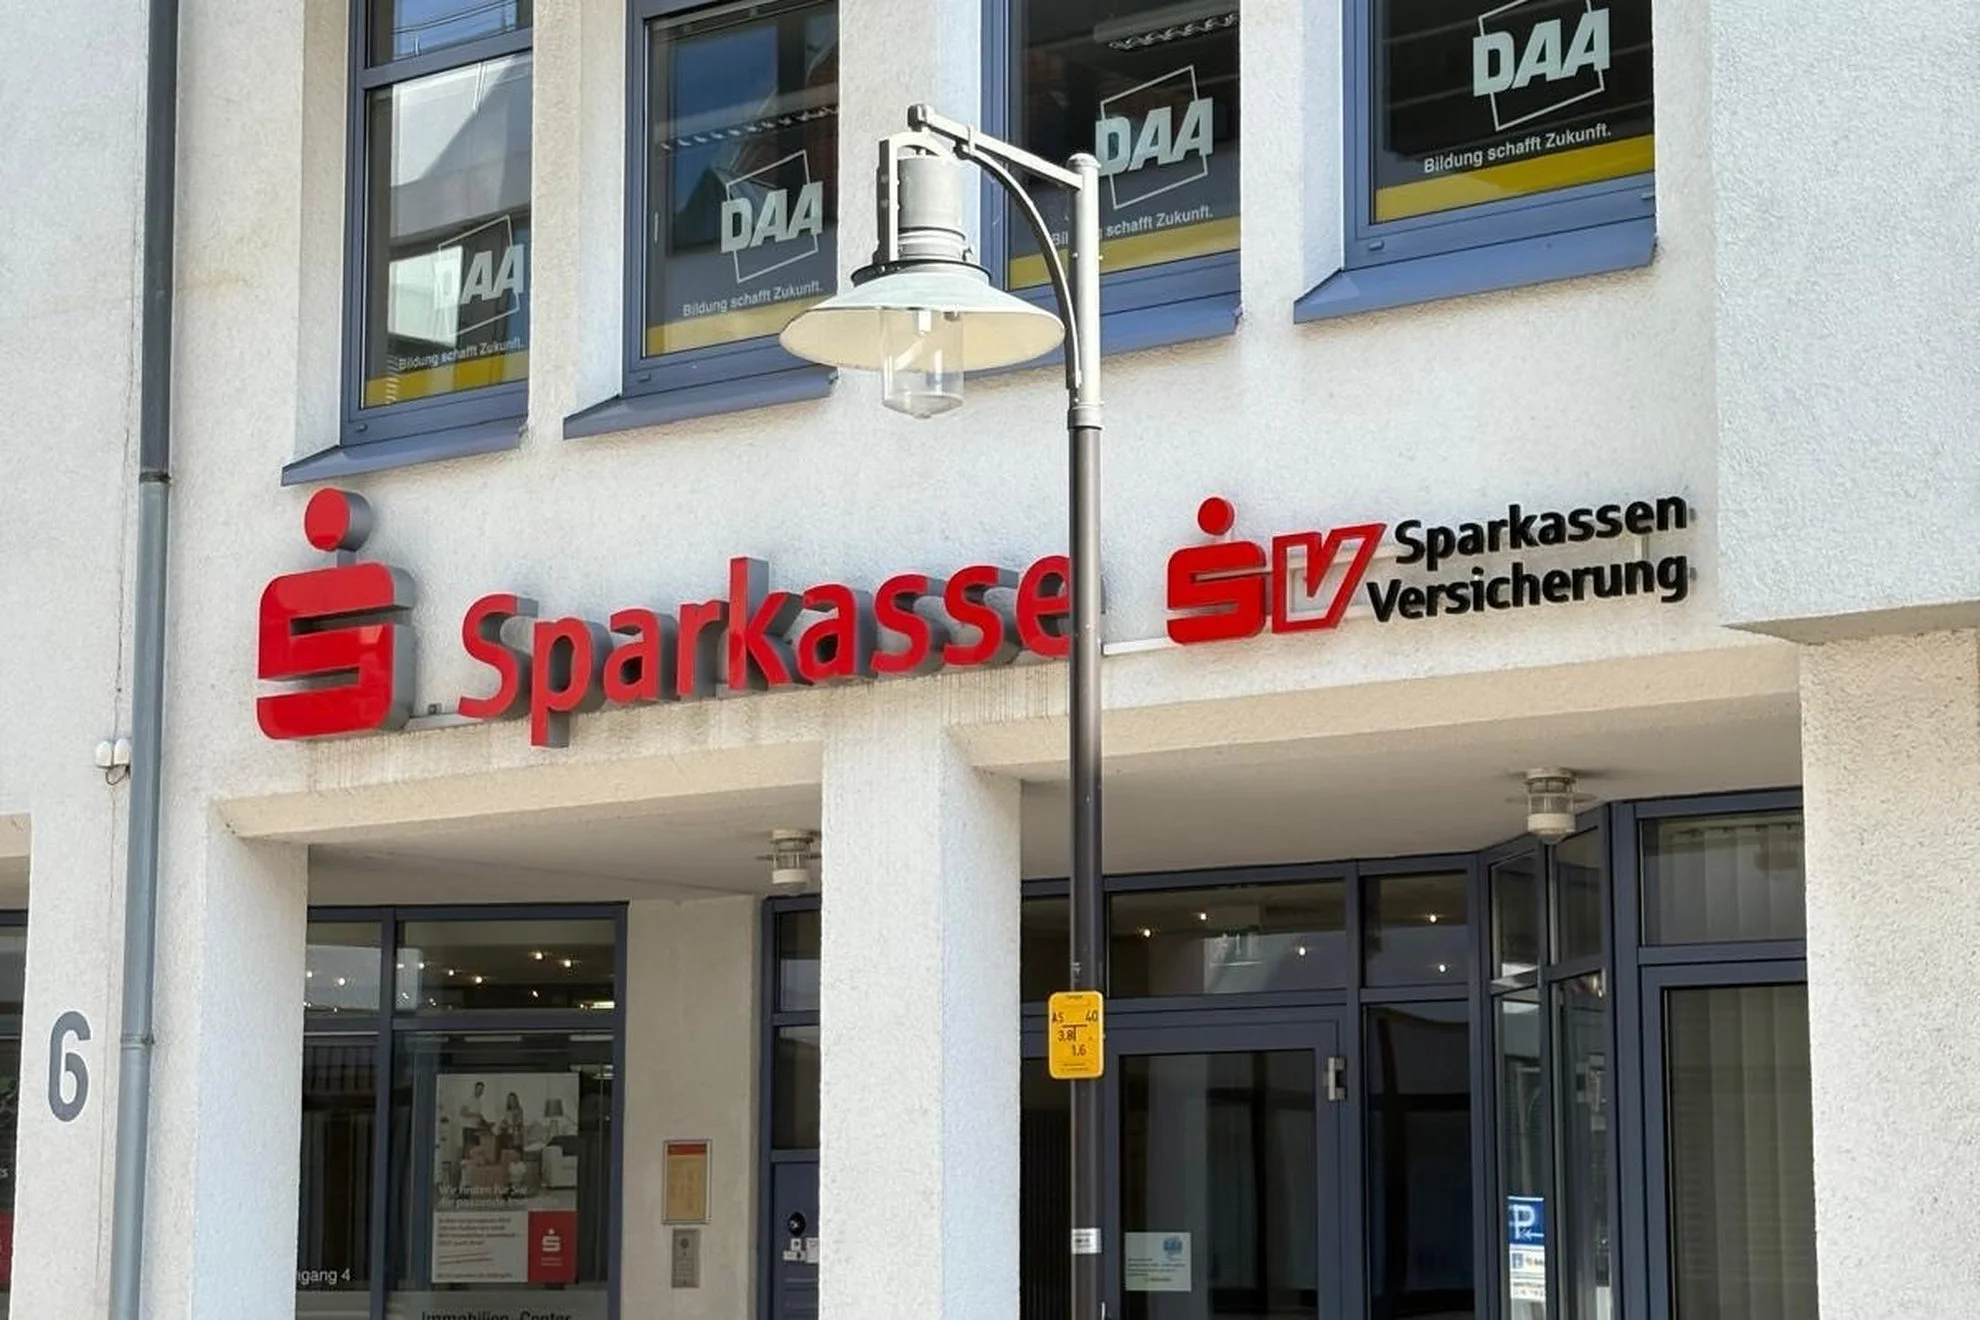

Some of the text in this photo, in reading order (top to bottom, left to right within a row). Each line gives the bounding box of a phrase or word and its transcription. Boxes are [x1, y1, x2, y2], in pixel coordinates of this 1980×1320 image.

[1473, 8, 1610, 97] DAA
[1095, 97, 1213, 177] DAA
[1424, 123, 1612, 174] Bildung schafft Zukunft.
[721, 181, 823, 253] DAA
[1105, 205, 1214, 237] schafft Zukunft.
[434, 243, 524, 312] DAA
[682, 298, 728, 316] Bildung
[730, 289, 771, 308] schafft
[398, 353, 439, 370] Bildung
[439, 345, 478, 362] schafft
[1395, 496, 1688, 570] Sparkassen
[1366, 555, 1688, 623] Versicherung
[459, 555, 1070, 747] Sparkasse
[1085, 1009, 1099, 1022] 40
[48, 1011, 91, 1122] 6
[297, 1268, 351, 1285] gang 4
